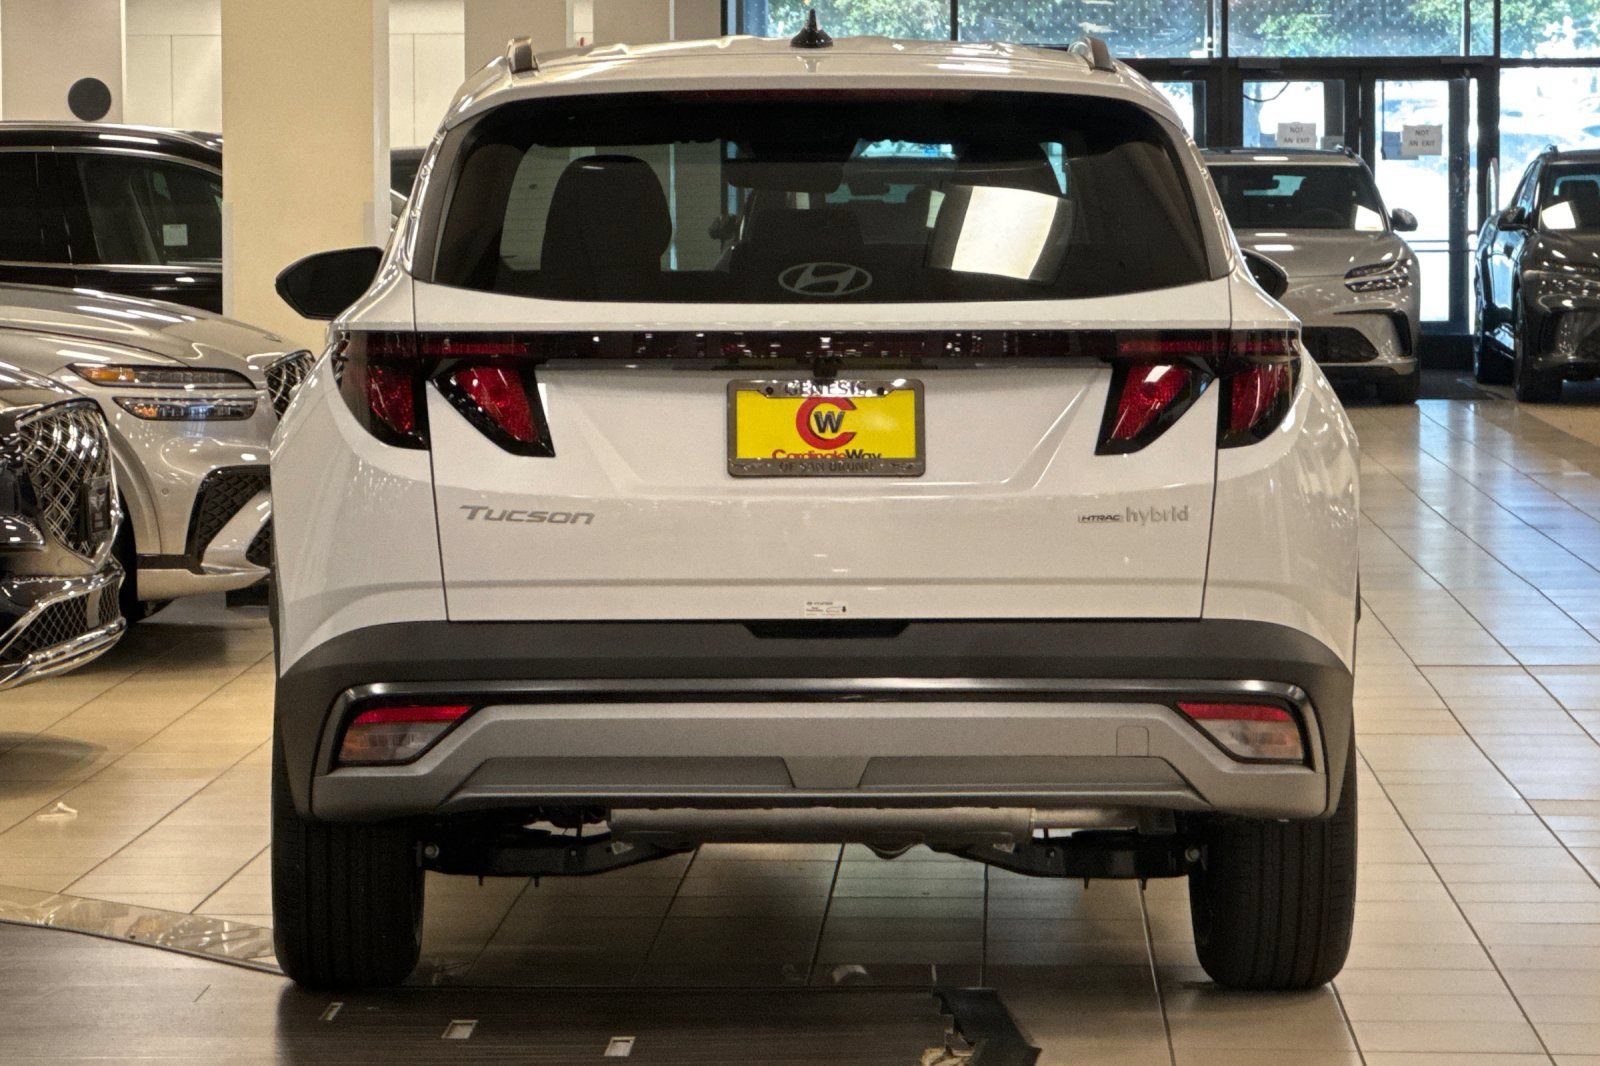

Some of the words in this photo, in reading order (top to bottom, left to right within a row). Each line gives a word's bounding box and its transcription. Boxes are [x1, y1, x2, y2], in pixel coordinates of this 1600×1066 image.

[1289, 126, 1304, 134] NOT
[800, 460, 825, 472] SAN
[1081, 514, 1122, 522] HTRAC
[1125, 504, 1189, 526] hybrid
